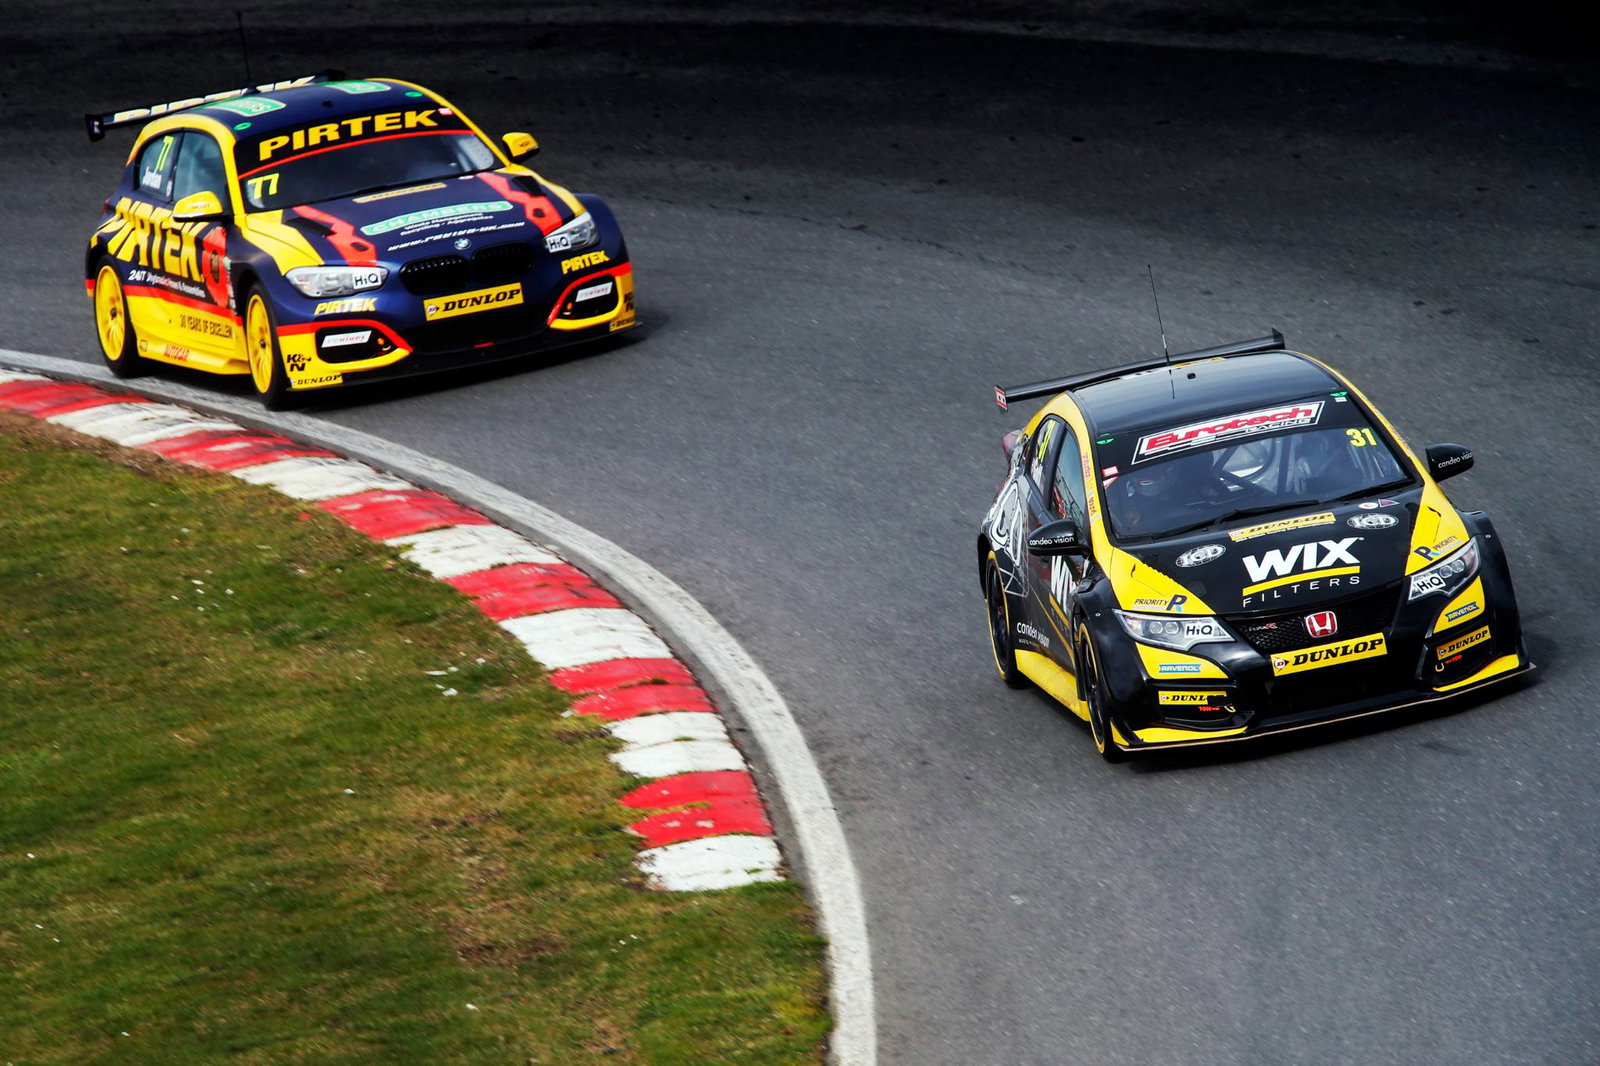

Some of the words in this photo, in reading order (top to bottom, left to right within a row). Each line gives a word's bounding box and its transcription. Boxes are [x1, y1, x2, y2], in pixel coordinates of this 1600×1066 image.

[259, 110, 438, 161] PIRTEK
[247, 173, 280, 199] 77
[549, 236, 569, 250] HiQ
[561, 250, 610, 274] PIRTEK
[354, 273, 379, 286] HiQ
[314, 297, 378, 315] PIRTEK
[442, 288, 521, 312] DUNLOP
[297, 373, 341, 385] DUNLOP
[1146, 407, 1313, 451] Eurotech
[1346, 428, 1377, 447] 31
[1242, 537, 1361, 583] WIX
[1243, 576, 1360, 608] FILTERS
[1416, 576, 1445, 592] HiQ
[1134, 598, 1169, 607] PRIORITY
[1186, 625, 1213, 636] HiQ
[1447, 629, 1489, 653] DUNLOP
[1291, 637, 1383, 667] DUNLOP
[1171, 694, 1207, 702] DUNL
